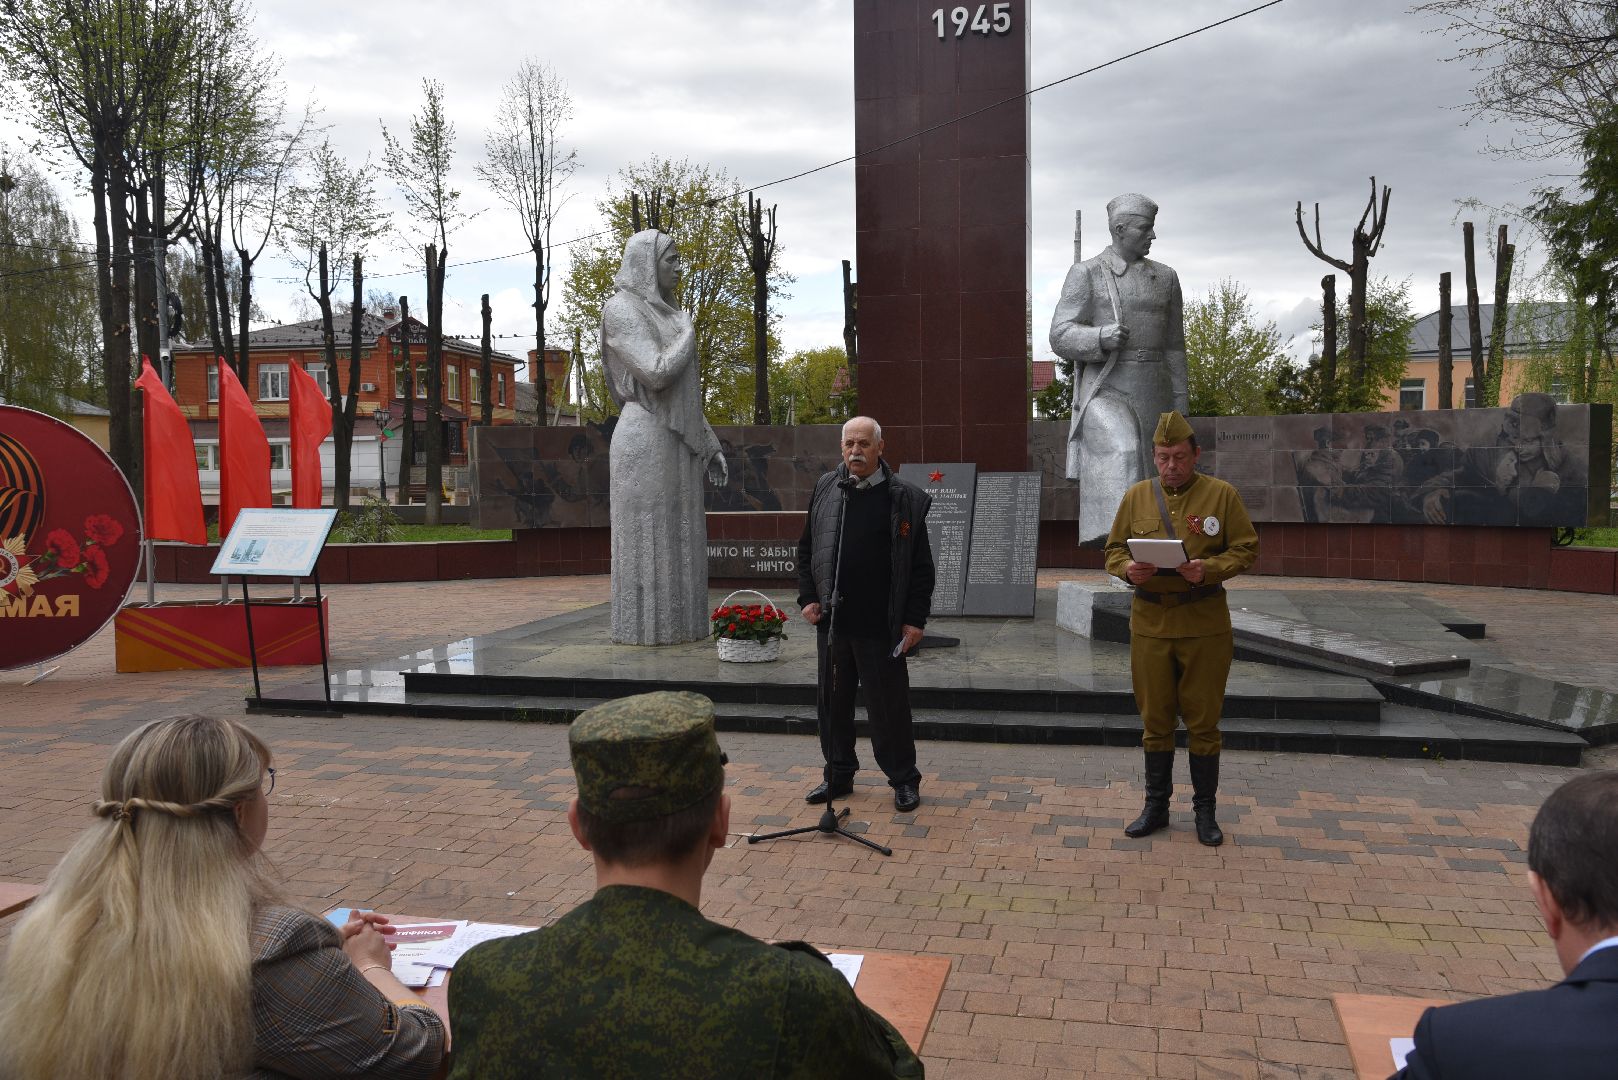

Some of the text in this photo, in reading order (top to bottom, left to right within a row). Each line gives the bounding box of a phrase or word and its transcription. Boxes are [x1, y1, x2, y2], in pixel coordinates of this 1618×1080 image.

[931, 2, 1011, 38] 1945
[742, 546, 756, 558] НЕ
[759, 546, 798, 557] ЗАБЫТ
[0, 594, 80, 618] МАЯ
